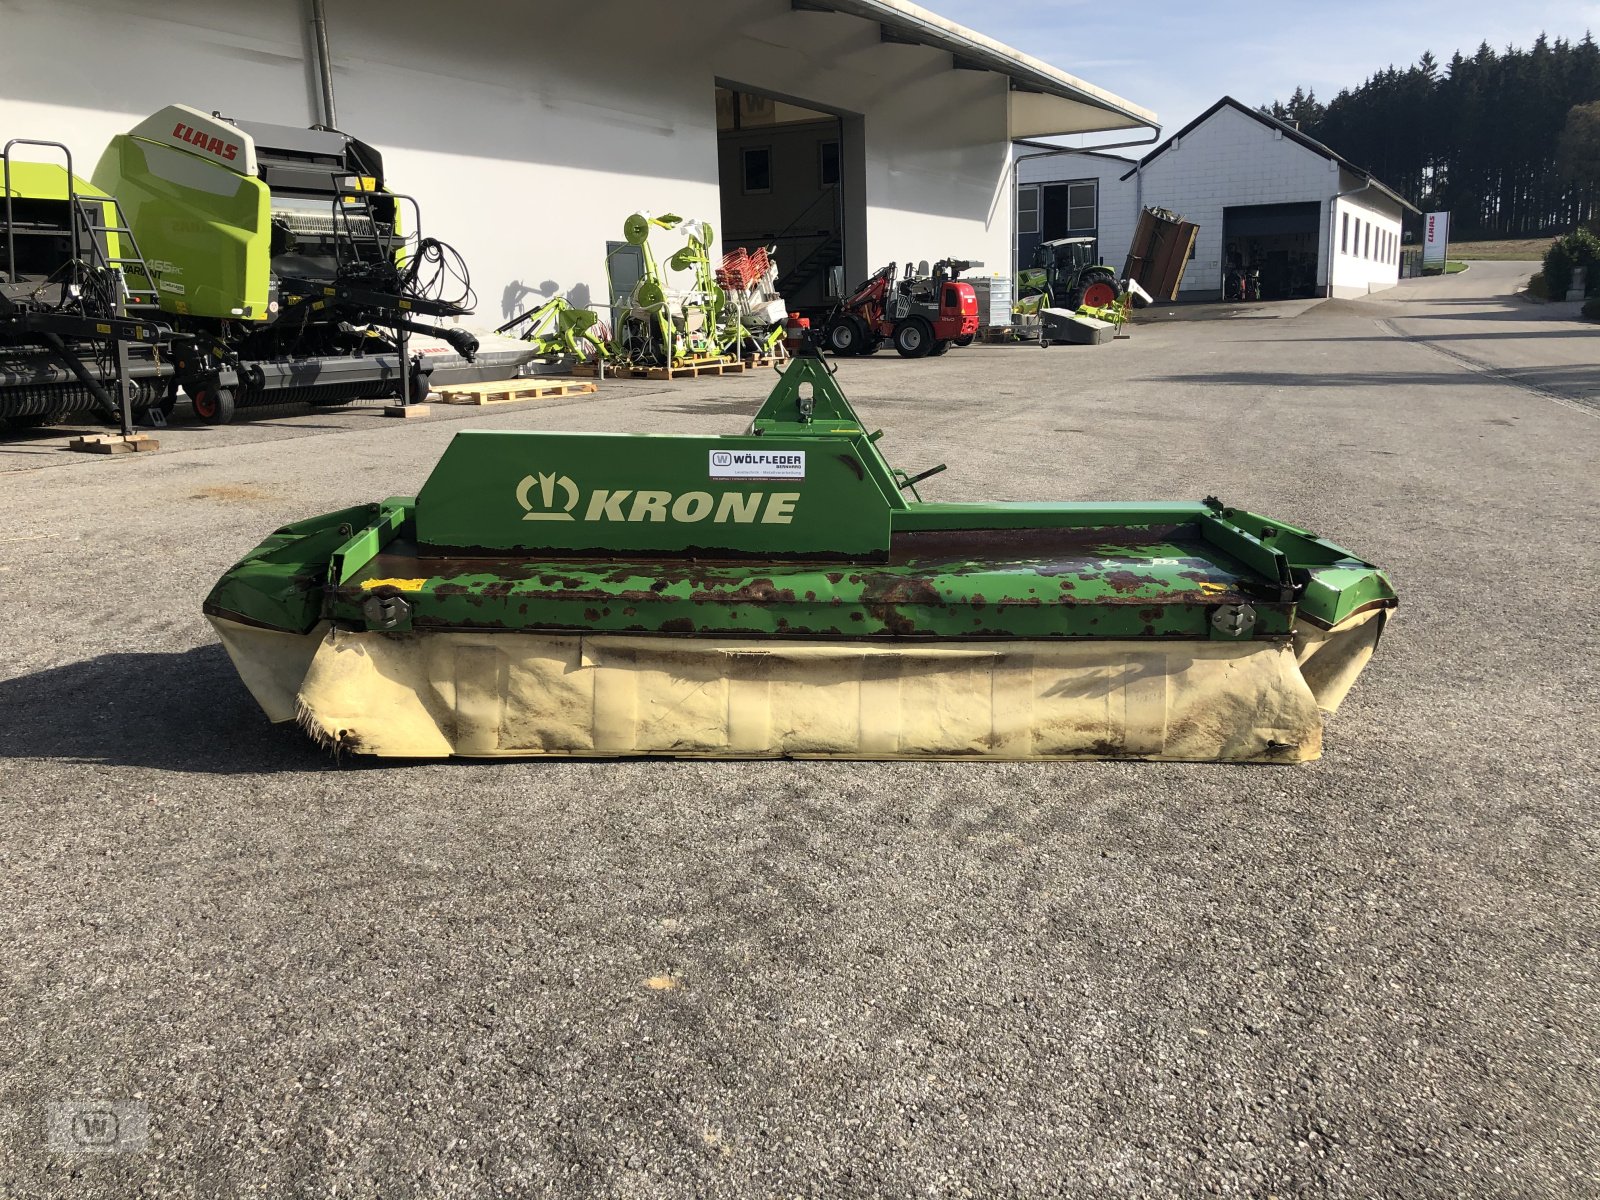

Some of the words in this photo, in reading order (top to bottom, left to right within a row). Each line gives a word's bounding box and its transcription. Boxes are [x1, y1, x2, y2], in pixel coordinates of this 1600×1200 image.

[173, 123, 238, 160] CLAAS
[122, 264, 162, 279] VARINT
[734, 454, 801, 464] WÖLFLEDER
[584, 490, 800, 524] KRONE
